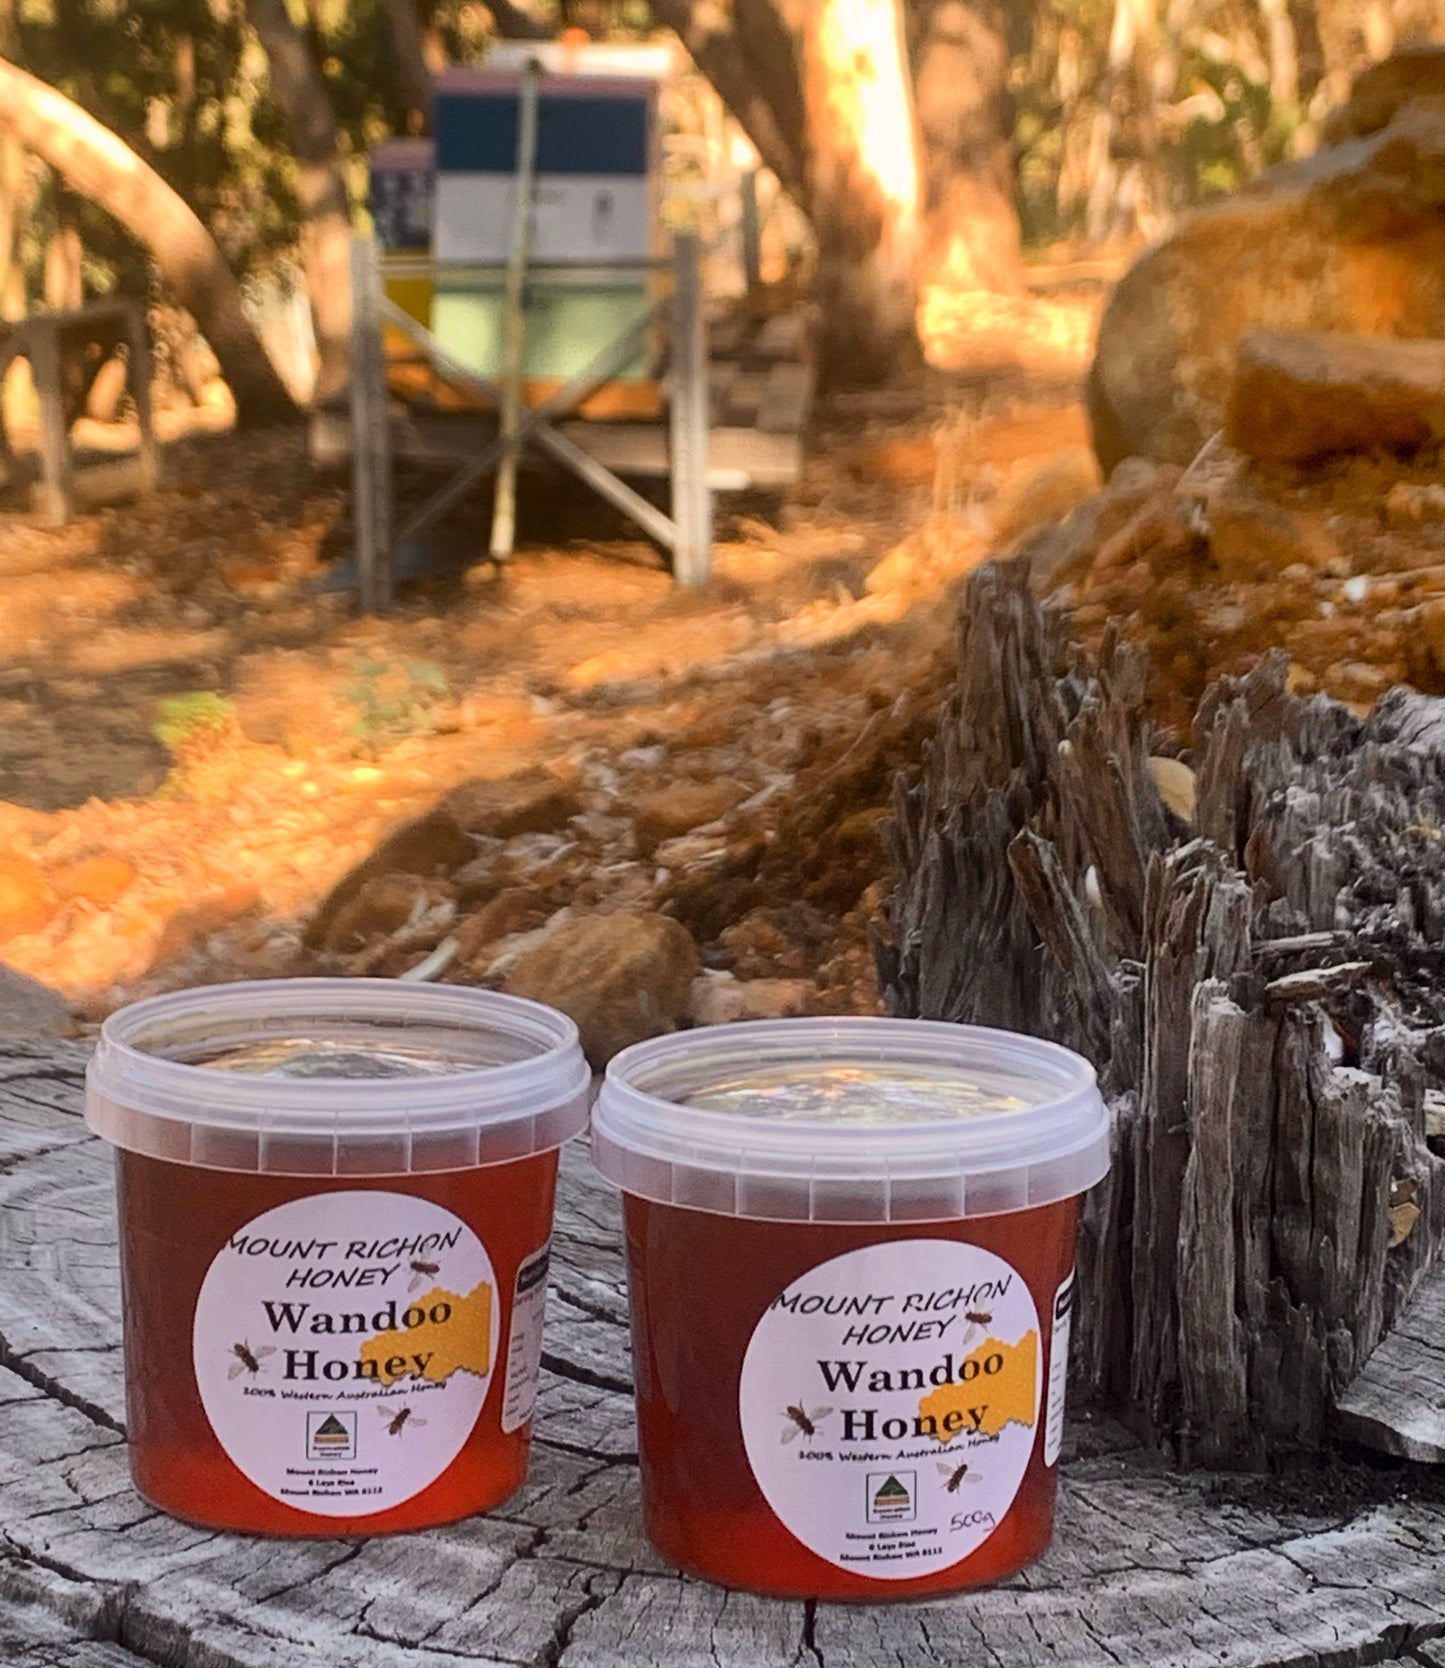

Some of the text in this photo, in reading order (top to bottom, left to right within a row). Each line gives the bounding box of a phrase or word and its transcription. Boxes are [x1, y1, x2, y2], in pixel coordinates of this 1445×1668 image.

[229, 1226, 462, 1260] MOUNT RICHON
[286, 1263, 401, 1288] HONEY
[771, 1274, 1012, 1316] MOUNT RICHON
[262, 1300, 452, 1334] Wandoo
[842, 1315, 956, 1346] HONEY
[282, 1348, 434, 1381] Honey
[817, 1353, 1004, 1393] Wandoo
[243, 1382, 447, 1401] 100% Western Australian Honey
[840, 1405, 989, 1441] Honey
[799, 1434, 1000, 1462] 100% Western Australian Honey
[950, 1510, 996, 1533] 500g
